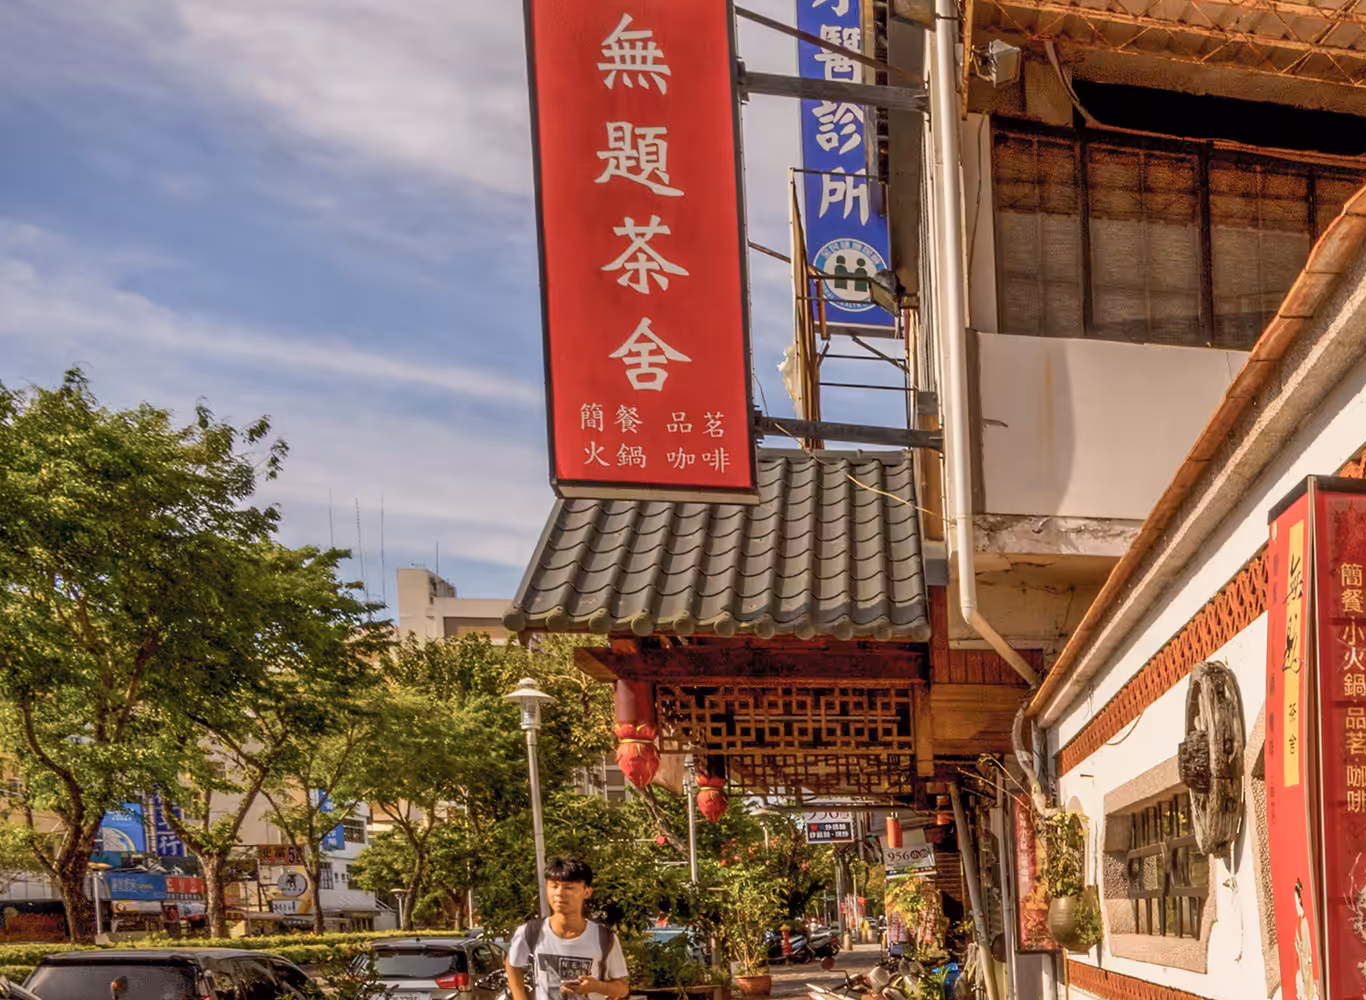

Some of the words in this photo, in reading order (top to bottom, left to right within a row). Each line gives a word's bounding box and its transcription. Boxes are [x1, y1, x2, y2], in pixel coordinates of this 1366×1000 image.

[594, 13, 692, 392] 無題茶舍
[580, 402, 644, 433] 簡餐
[666, 411, 725, 438] 品茗
[584, 440, 647, 468] 火鍋
[666, 447, 731, 474] 咖啡
